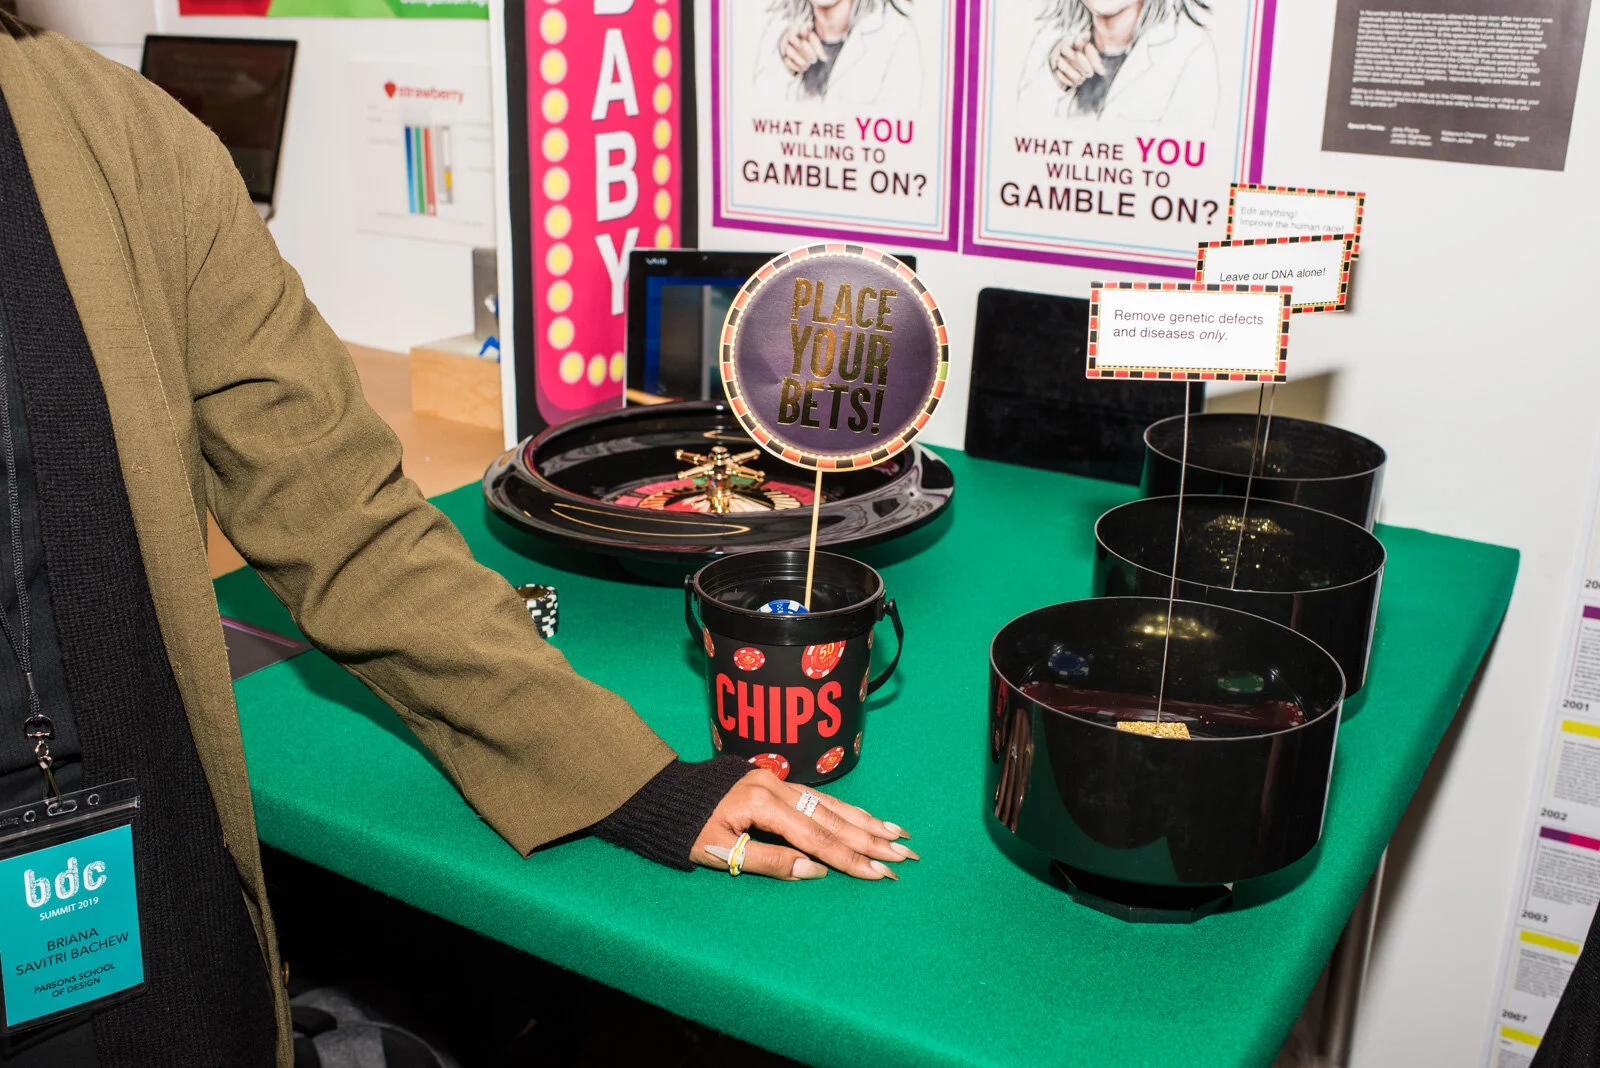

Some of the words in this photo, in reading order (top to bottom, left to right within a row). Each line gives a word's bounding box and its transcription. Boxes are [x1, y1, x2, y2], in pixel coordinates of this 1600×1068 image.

[398, 86, 464, 103] strawberry
[753, 118, 802, 136] WHAT
[810, 123, 845, 139] ARE
[856, 117, 914, 143] YOU
[591, 0, 640, 316] ABY
[781, 142, 854, 162] WILLING
[862, 148, 886, 163] TO
[1015, 137, 1073, 156] WHAT
[1081, 142, 1124, 160] ARE
[1136, 137, 1205, 167] YOU
[743, 161, 857, 191] GAMBLE
[870, 170, 927, 197] ON?
[1047, 163, 1133, 184] WILLING
[1142, 170, 1170, 188] TO
[1000, 182, 1136, 218] GAMBLE
[1151, 196, 1218, 225] ON?
[1240, 206, 1256, 215] Edit
[1259, 208, 1298, 220] anything!
[1240, 218, 1273, 229] Improve
[1275, 220, 1288, 229] the
[1291, 222, 1320, 231] human
[1323, 224, 1345, 232] race!
[1220, 272, 1249, 282] Leave
[1252, 271, 1269, 280] our
[1272, 269, 1294, 280] DNA
[1296, 267, 1326, 279] alone!
[791, 278, 898, 333] PLACE
[1114, 309, 1165, 322] Remove
[1170, 311, 1214, 324] genetic
[1219, 313, 1264, 325] defects
[1113, 327, 1136, 337] and
[1140, 327, 1195, 339] diseases
[1199, 329, 1228, 341] only.
[790, 322, 892, 386] YOUR
[778, 377, 884, 435] BETS!
[819, 642, 834, 660] 50
[716, 673, 842, 744] CHIPS
[1563, 700, 1590, 712] 2001
[1540, 808, 1567, 821] 2002
[24, 856, 107, 908] bdc
[39, 903, 76, 921] SUMMIT
[78, 897, 99, 910] 2019
[1522, 910, 1548, 923] 2003
[47, 927, 99, 952] BRIANA
[15, 952, 67, 976] SAVITRI
[71, 931, 129, 958] BACHEW
[34, 975, 77, 994] PARSONS
[78, 963, 116, 981] SCHOOL
[52, 988, 65, 998] OF
[66, 977, 100, 994] DESIGN
